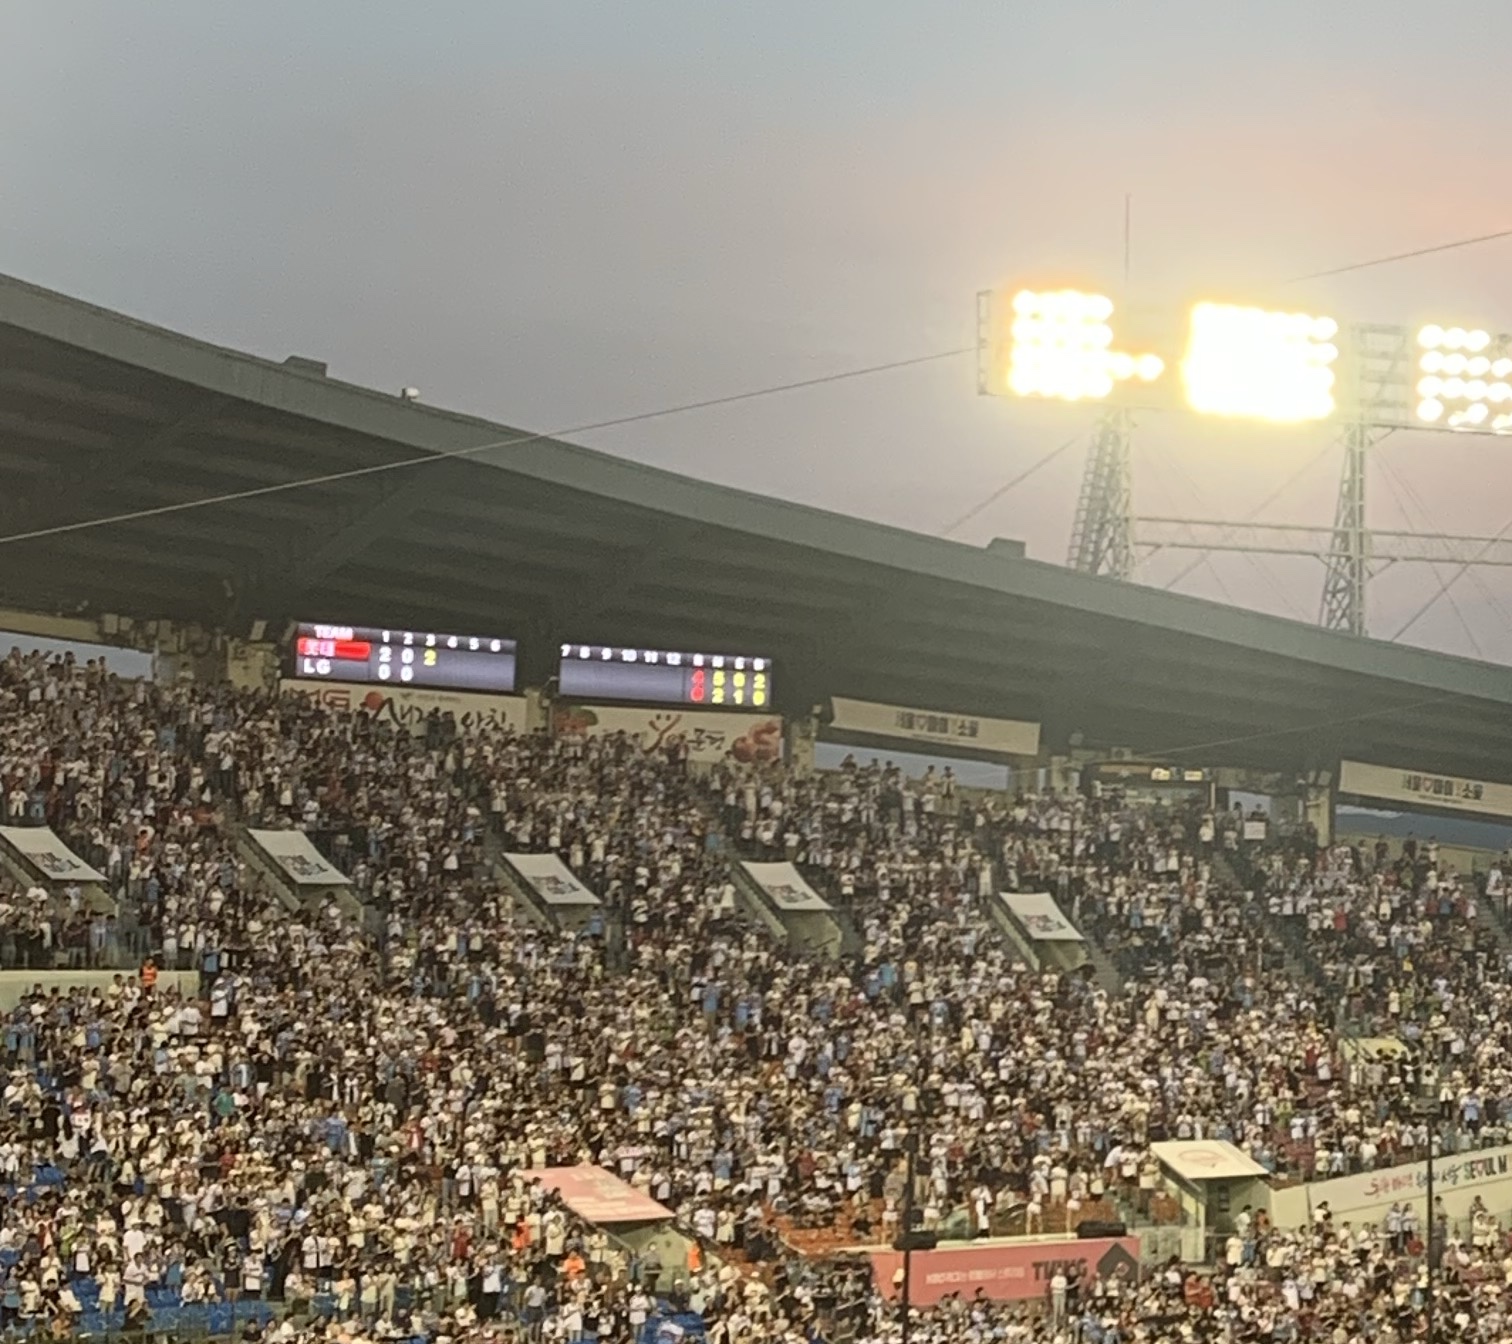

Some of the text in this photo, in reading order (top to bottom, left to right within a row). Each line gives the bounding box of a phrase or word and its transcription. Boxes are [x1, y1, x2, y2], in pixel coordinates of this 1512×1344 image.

[314, 625, 501, 652] TEAM 1 2 3 4 5 6
[379, 646, 392, 663] 2
[402, 648, 414, 664] 0
[424, 649, 437, 666] 2
[561, 644, 571, 657] 7
[579, 646, 590, 659] 8
[601, 647, 612, 660] 9
[621, 649, 637, 662] 10
[644, 650, 658, 663] 11
[303, 658, 414, 682] LG 0 0
[753, 673, 766, 689] 2
[711, 687, 725, 704] 2
[733, 689, 744, 704] 1
